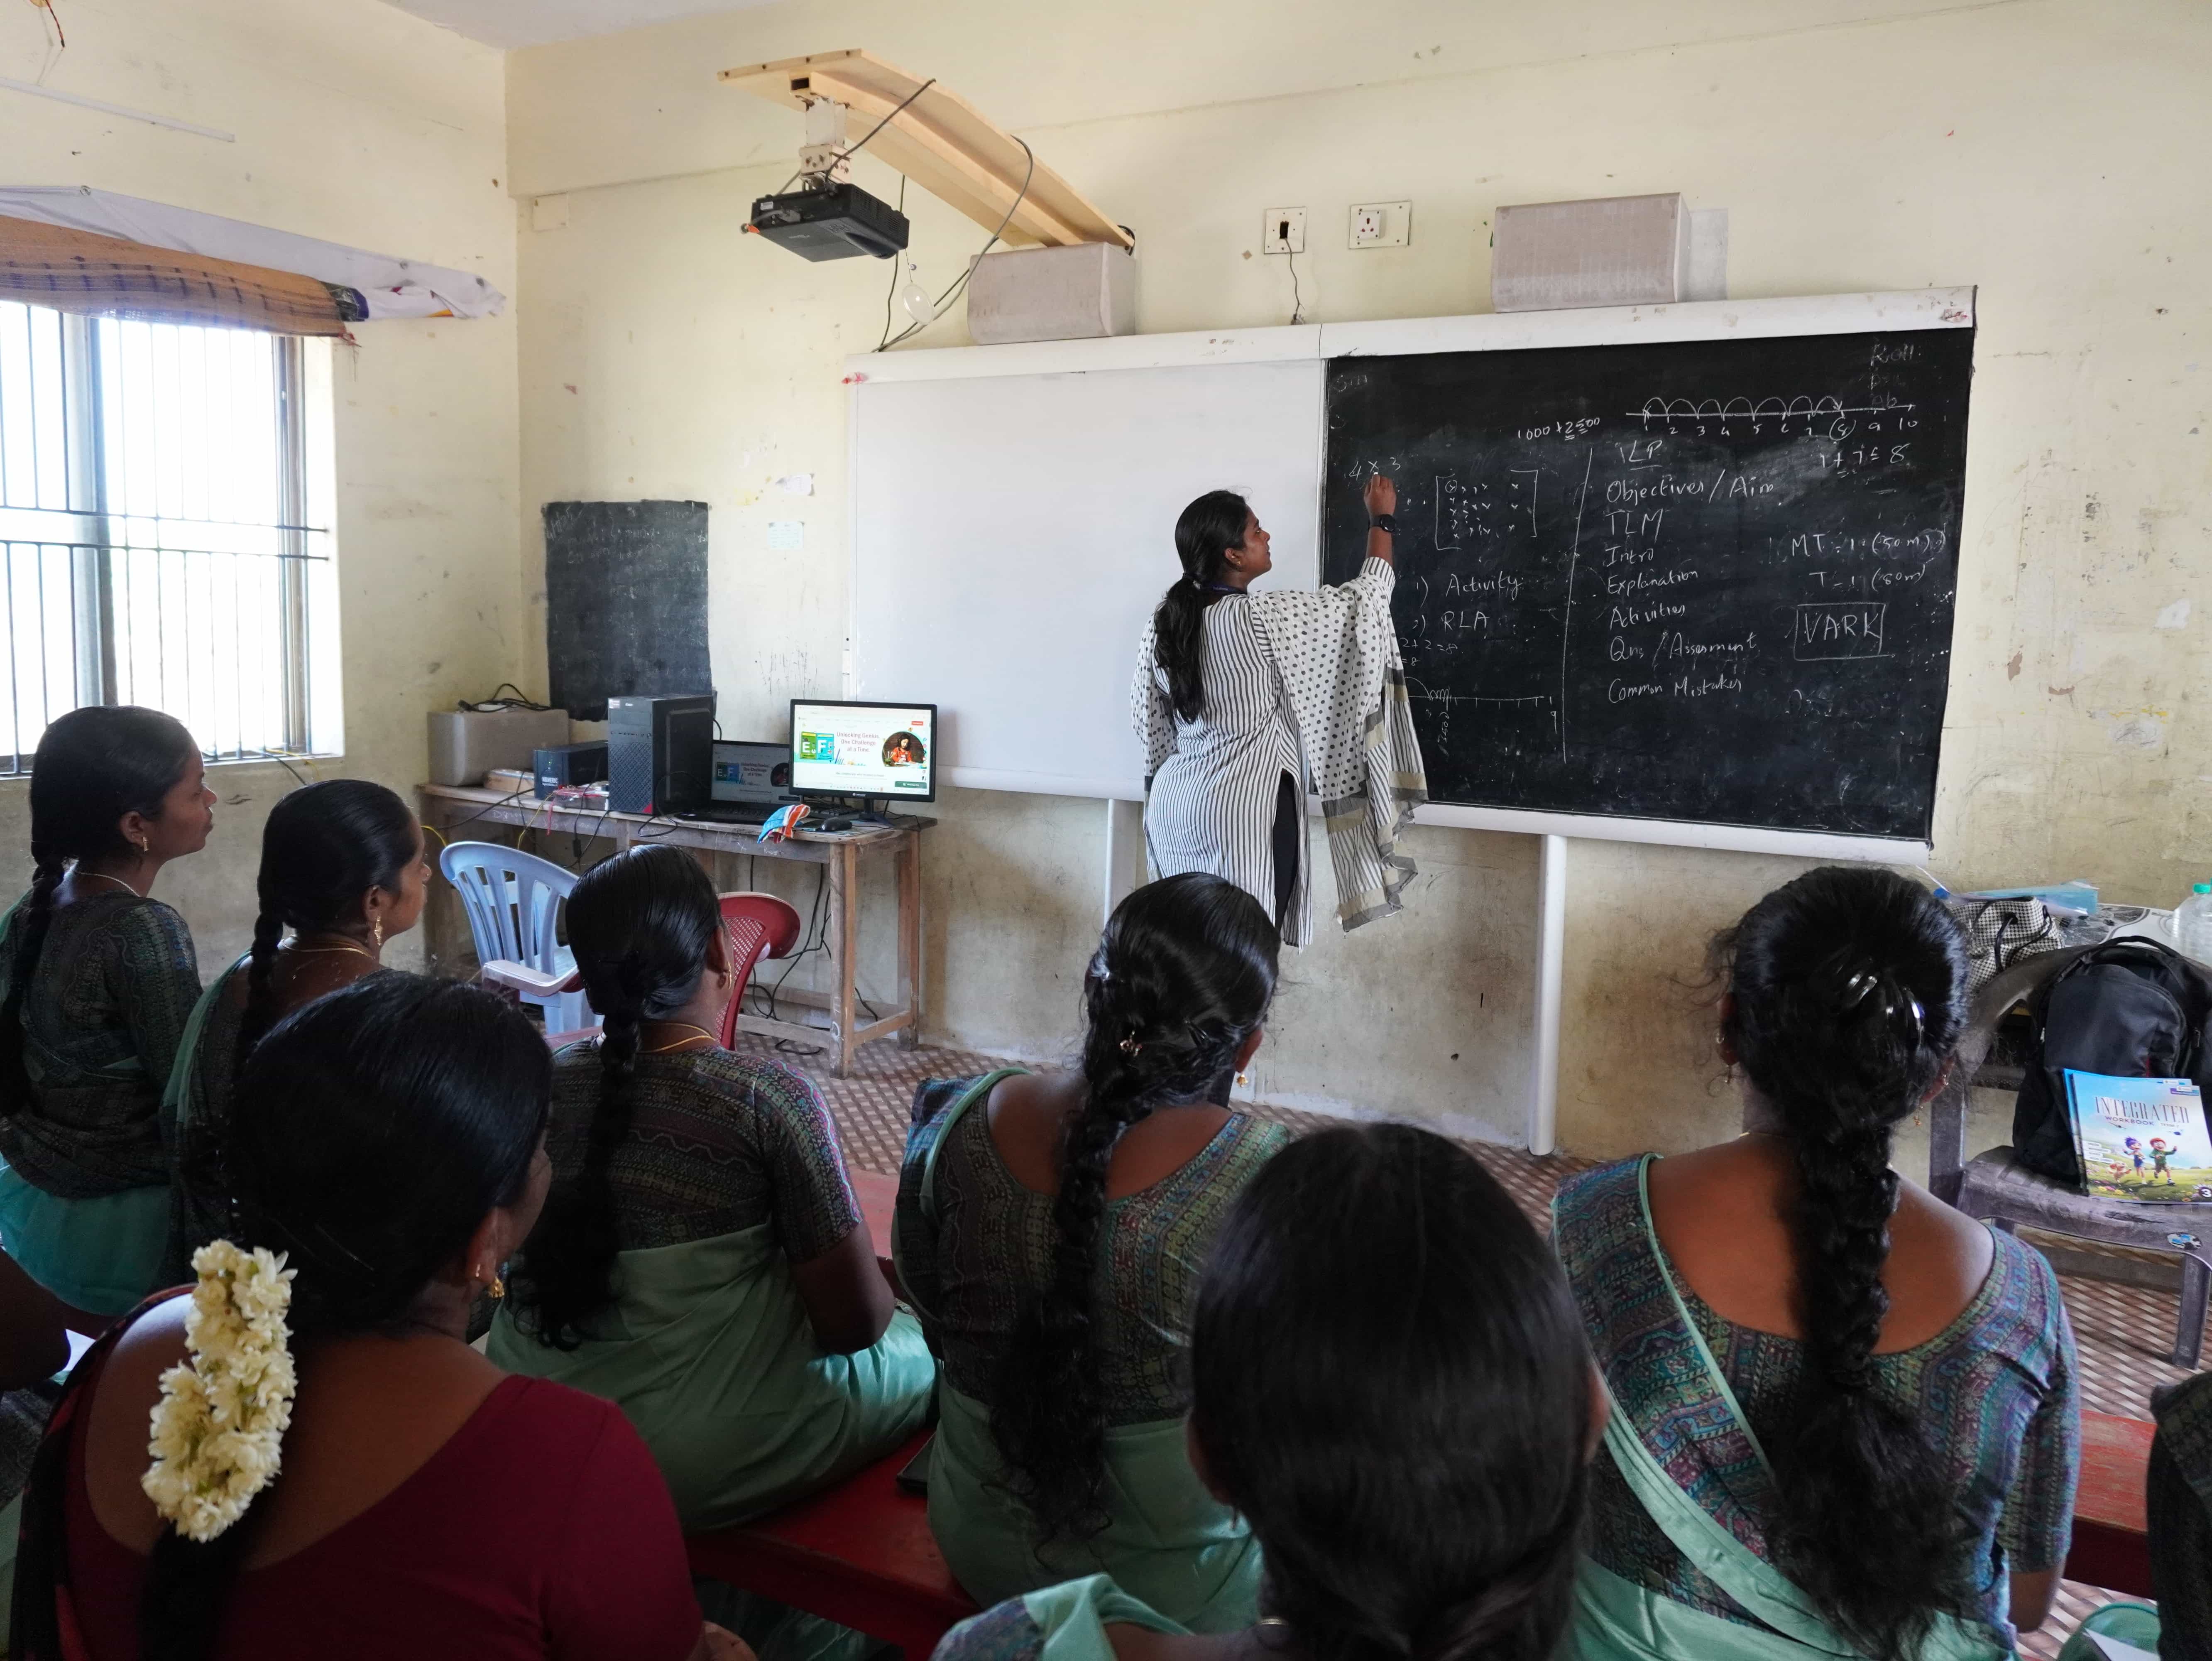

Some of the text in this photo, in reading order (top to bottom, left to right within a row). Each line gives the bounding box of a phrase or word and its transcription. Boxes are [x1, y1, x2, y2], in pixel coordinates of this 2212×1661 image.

[1697, 426, 1705, 436] 3
[1721, 426, 1730, 437] 4
[1753, 424, 1763, 435] 5
[1868, 422, 1881, 431] 9
[1899, 417, 1918, 430] 10
[1890, 443, 1911, 463] 8
[1349, 461, 1362, 481] 4
[1390, 457, 1401, 471] 3
[1605, 508, 1665, 544] TLM
[1605, 546, 1654, 567] Intro
[1446, 571, 1523, 601] Activity
[1608, 570, 1698, 596] Explanation
[1440, 611, 1491, 632] RLA
[1610, 601, 1686, 630] Activities
[1804, 612, 1881, 643] VARK
[1608, 673, 1742, 703] Common Mistakes
[802, 740, 827, 753] E F
[2095, 1096, 2190, 1124] INTEGRATED
[2104, 1115, 2155, 1126] WORKBOOK
[2201, 1188, 2212, 1198] 3
